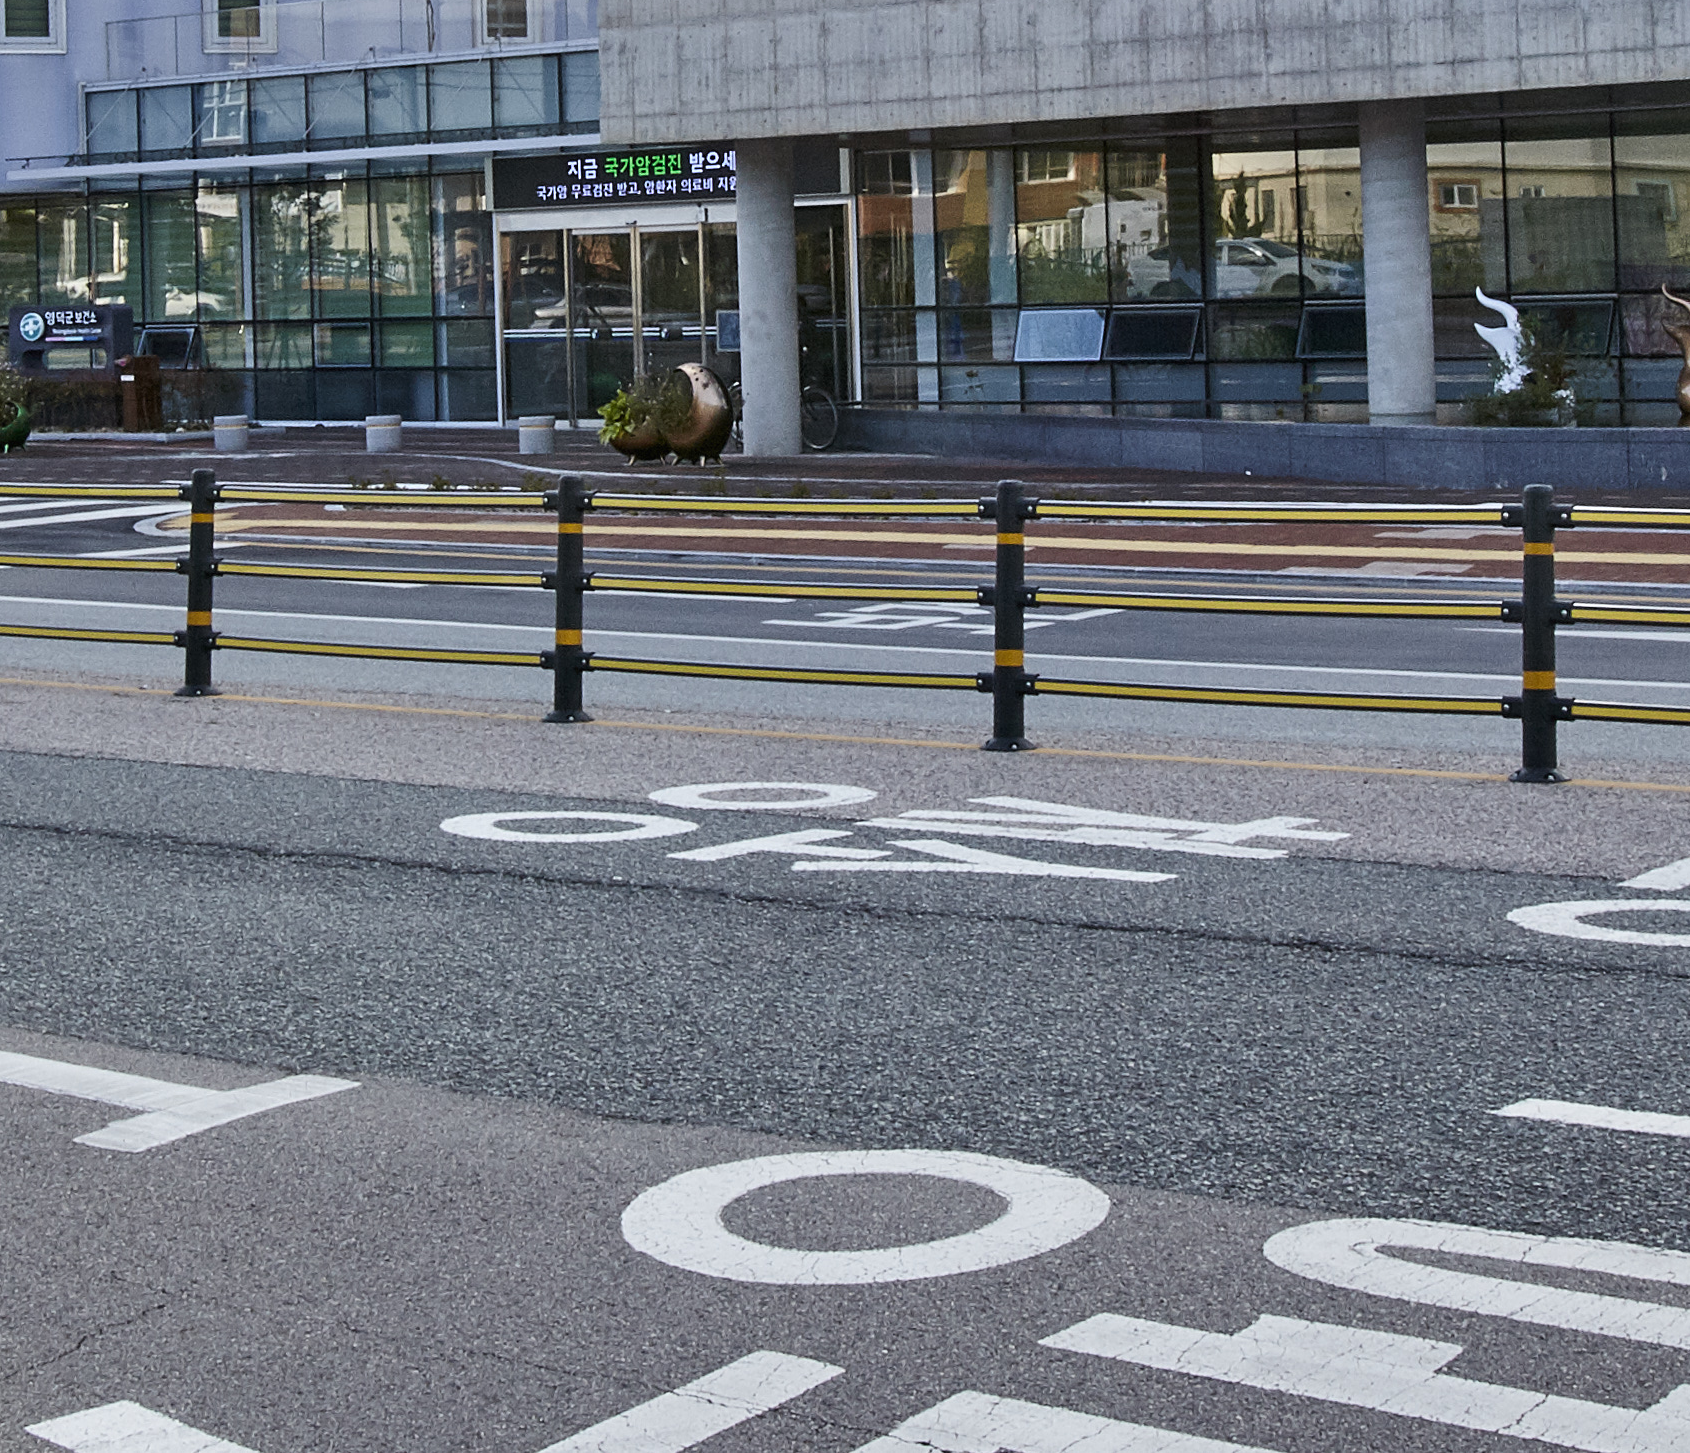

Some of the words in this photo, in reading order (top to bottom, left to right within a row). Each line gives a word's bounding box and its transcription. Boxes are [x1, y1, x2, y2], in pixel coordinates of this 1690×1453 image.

[567, 158, 599, 180] 지금
[603, 152, 683, 178] 국가암검진
[571, 182, 614, 199] 무료검진
[680, 177, 714, 193] 의료비
[44, 311, 74, 326] 영덕군
[74, 310, 98, 325] 보건소
